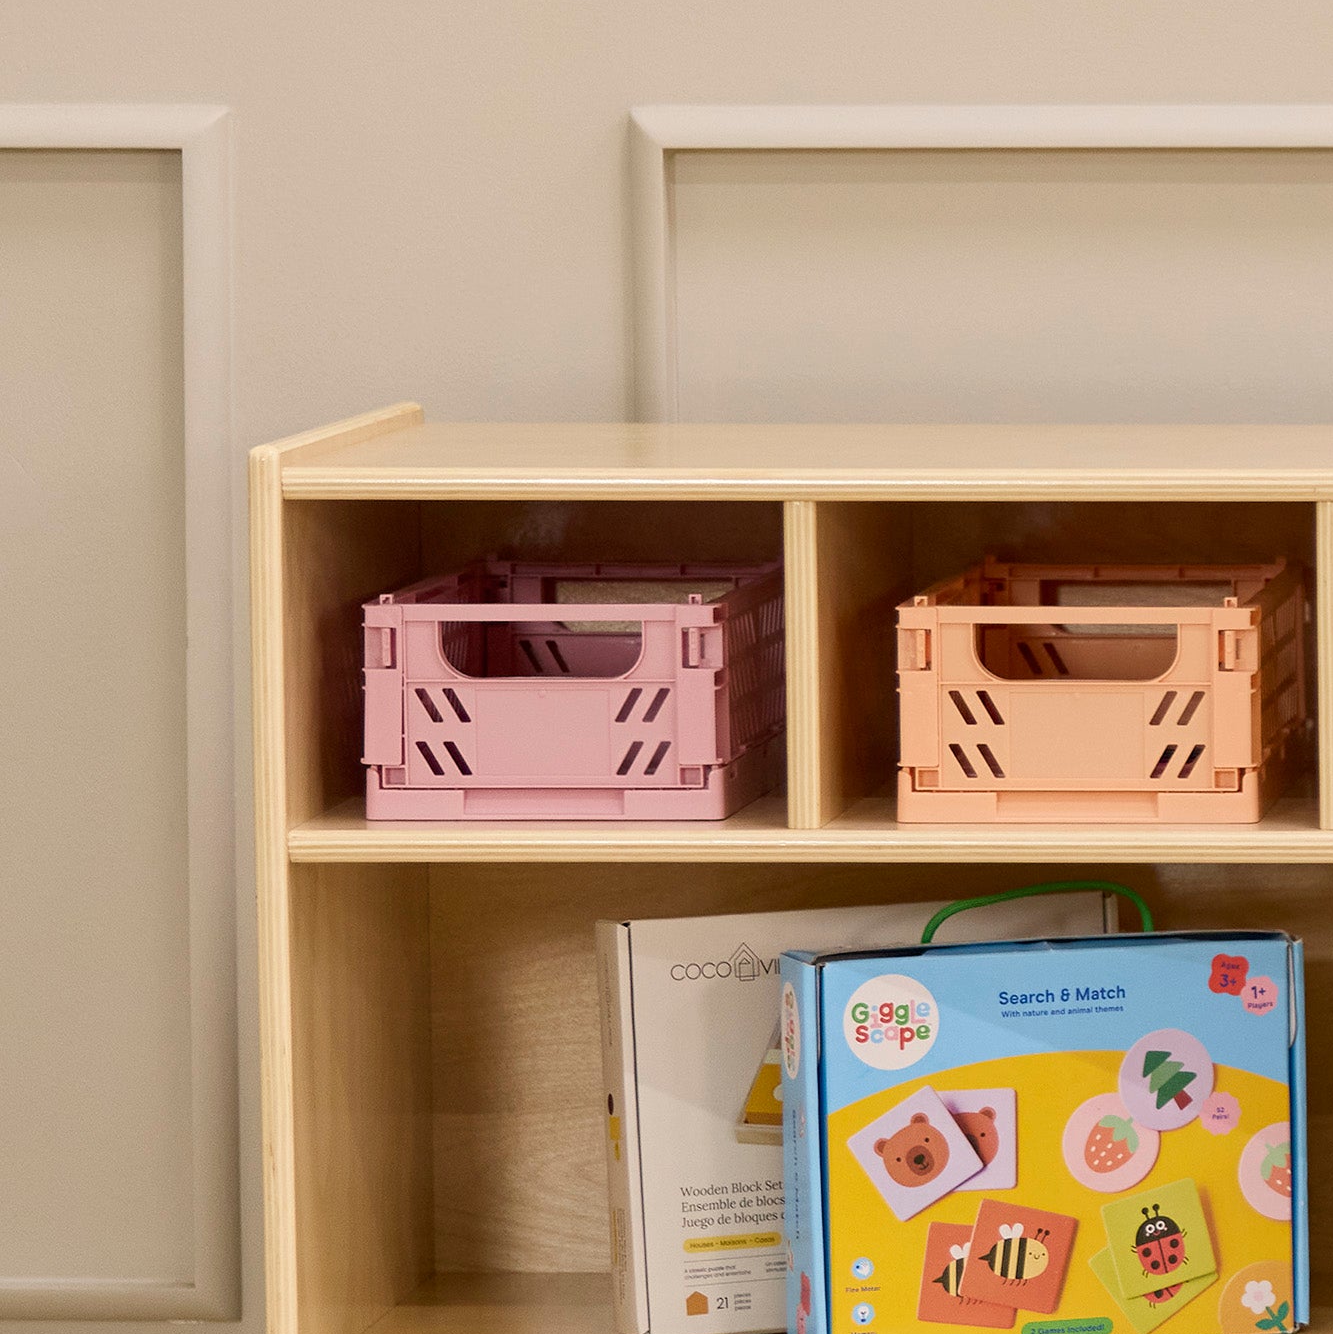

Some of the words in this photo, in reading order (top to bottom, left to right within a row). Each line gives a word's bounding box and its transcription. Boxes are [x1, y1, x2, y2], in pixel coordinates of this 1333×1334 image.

[670, 961, 732, 981] COCO
[1219, 974, 1237, 988] 3+
[998, 989, 1055, 1005] Search
[1060, 988, 1071, 1002] &
[1076, 985, 1126, 1001] Match
[1251, 985, 1266, 999] 1+
[1001, 1009, 1021, 1018] With
[1022, 1008, 1048, 1017] nature
[1050, 1007, 1066, 1016] and
[1068, 1006, 1093, 1015] animal
[1095, 1005, 1124, 1013] themes
[1247, 1001, 1274, 1010] Players
[680, 1185, 729, 1197] Wooden
[731, 1181, 763, 1194] Block
[765, 1180, 784, 1192] Set
[681, 1198, 737, 1213] Ensemble
[739, 1197, 754, 1208] de
[756, 1195, 786, 1207] blocs
[681, 1216, 715, 1229] Juego
[717, 1214, 732, 1225] de
[734, 1212, 779, 1225] bloques
[715, 1296, 730, 1310] 21
